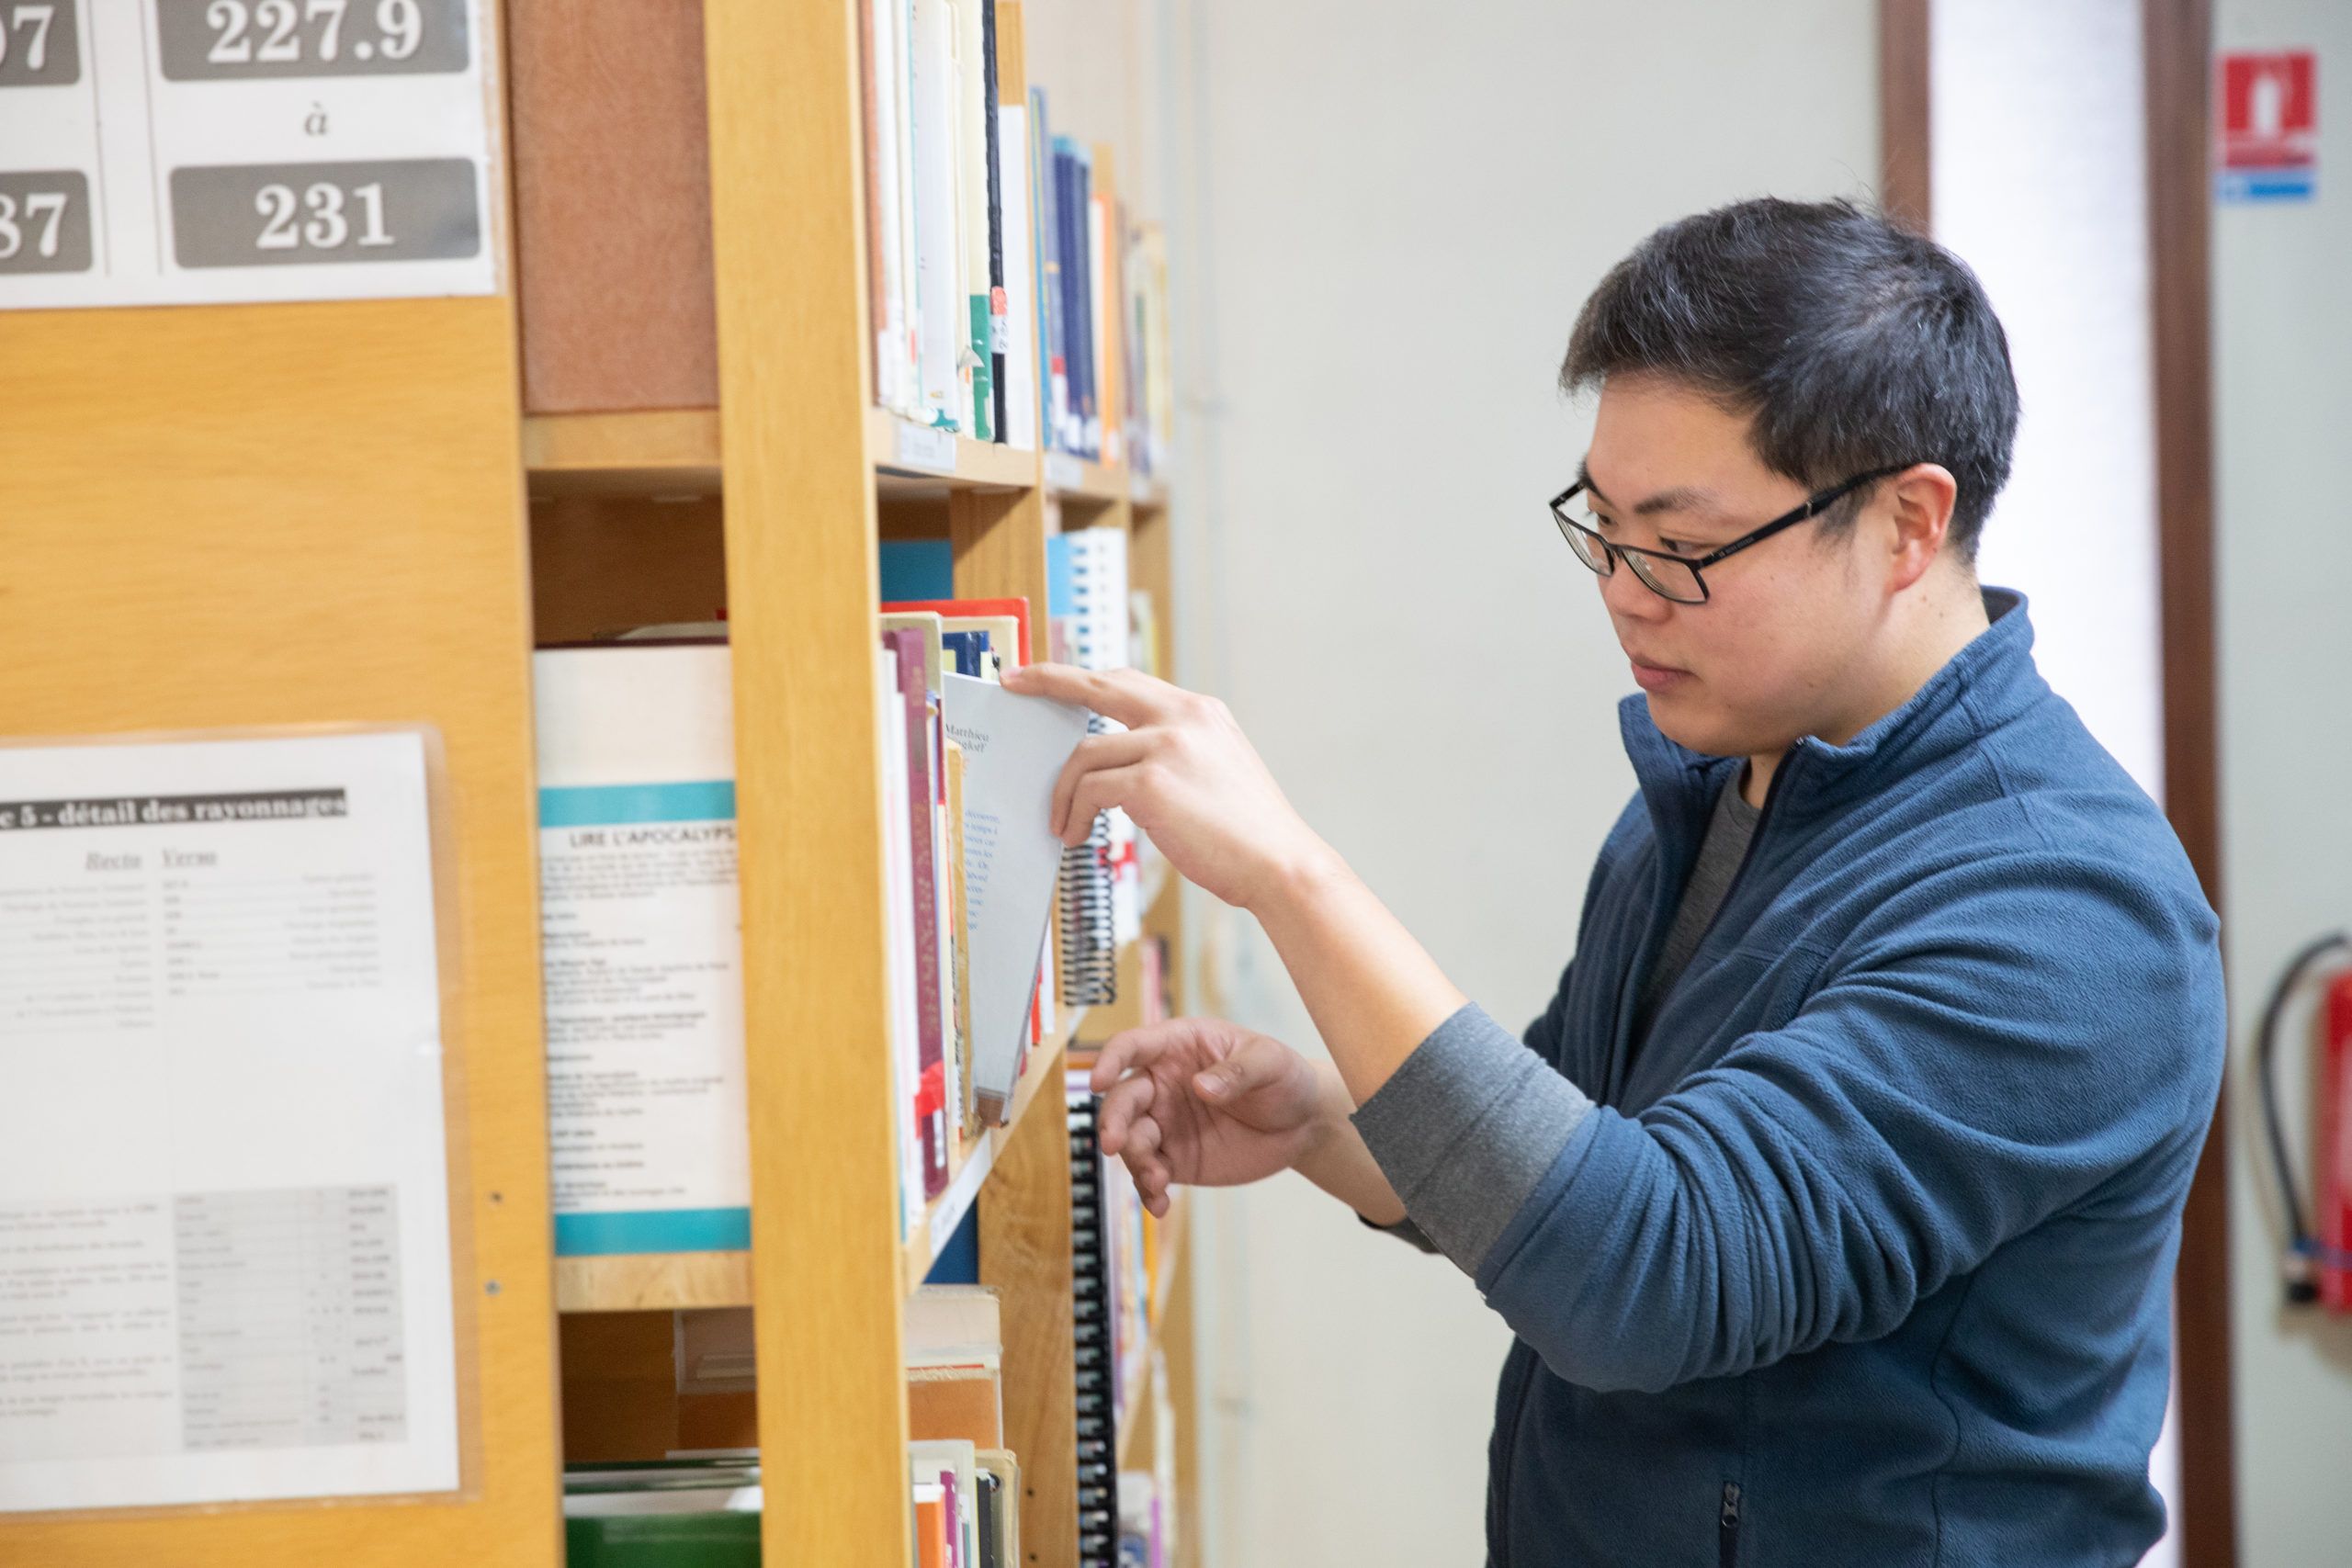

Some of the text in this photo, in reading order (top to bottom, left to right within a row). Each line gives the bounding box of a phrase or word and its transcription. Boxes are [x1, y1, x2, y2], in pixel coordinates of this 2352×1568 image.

[0, 6, 54, 71] 7
[207, 0, 423, 63] 227.9
[304, 103, 329, 136] à
[254, 184, 396, 249] 231
[58, 798, 137, 825] détail
[141, 797, 189, 823] des
[194, 797, 346, 820] rayonnages
[570, 829, 605, 848] LIRE
